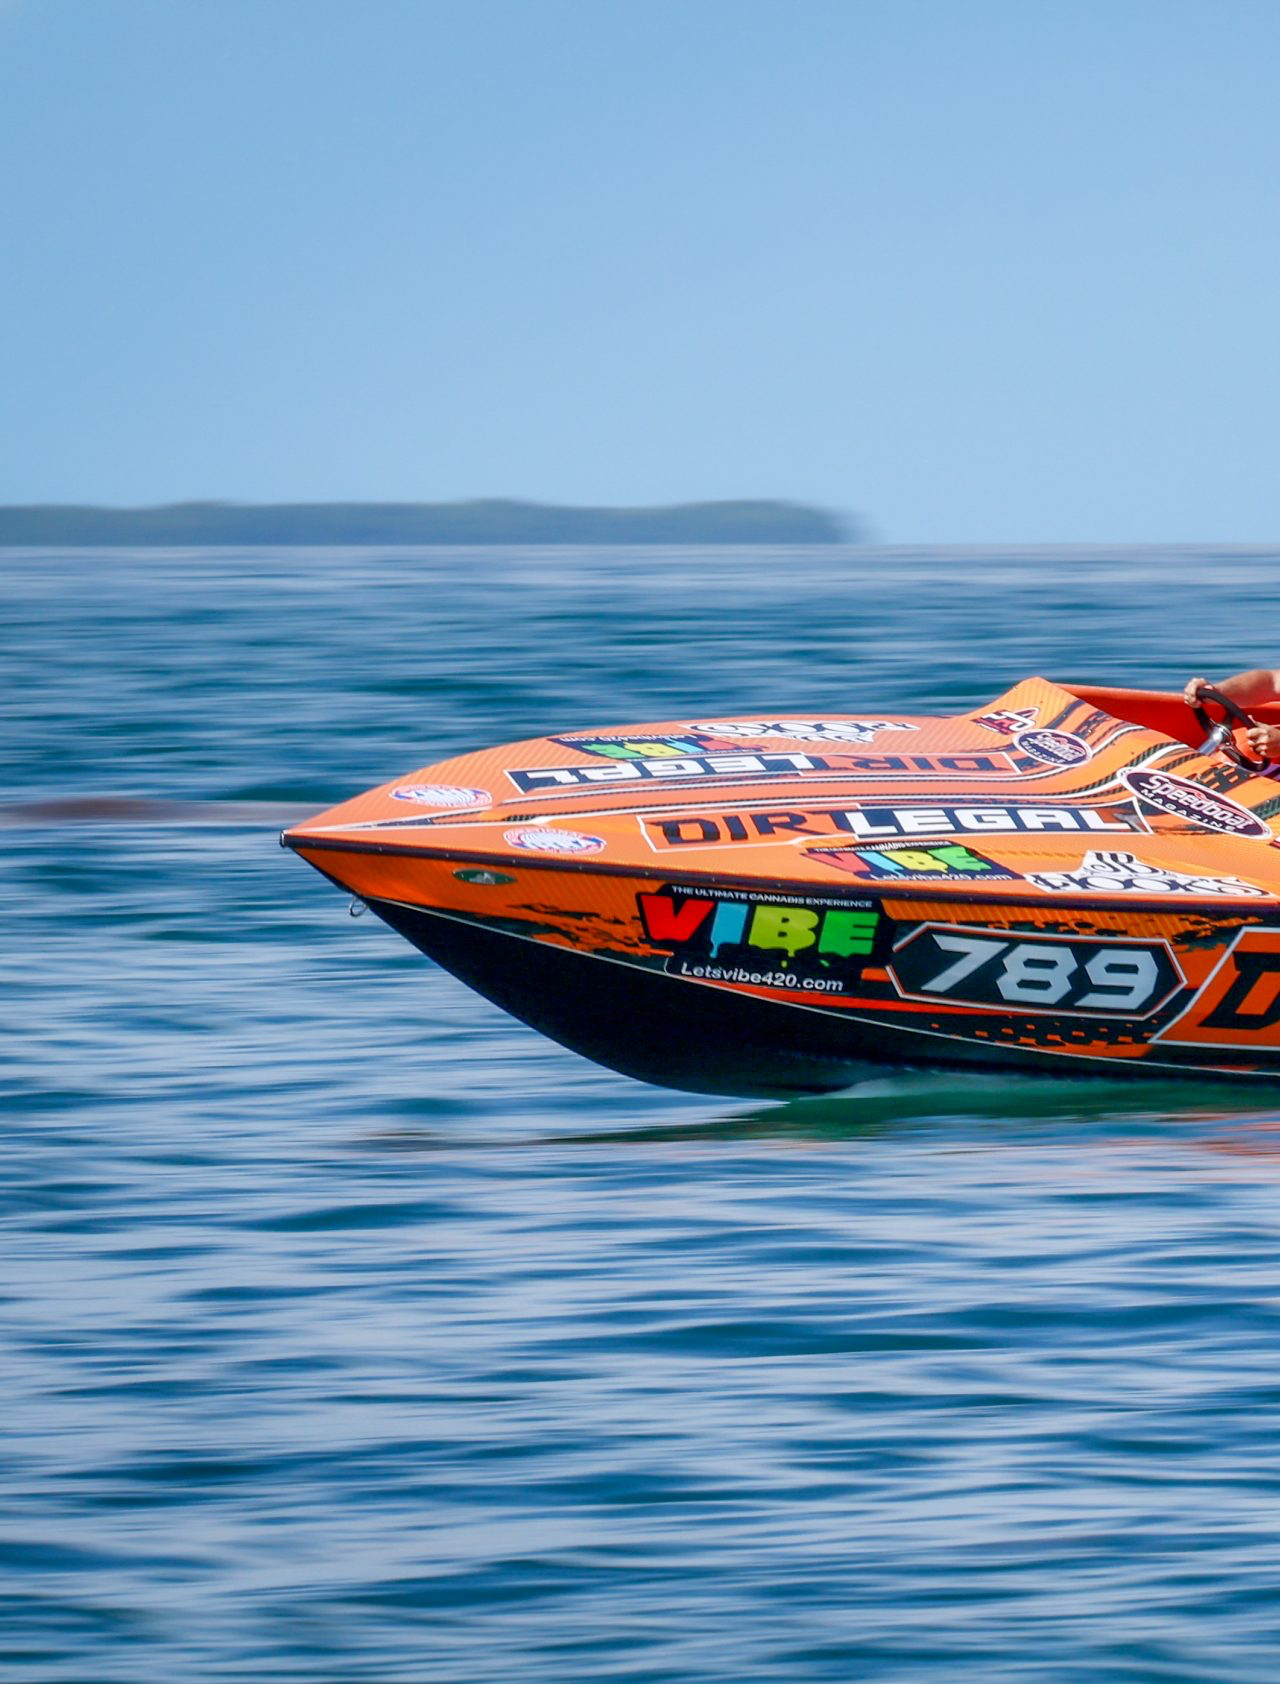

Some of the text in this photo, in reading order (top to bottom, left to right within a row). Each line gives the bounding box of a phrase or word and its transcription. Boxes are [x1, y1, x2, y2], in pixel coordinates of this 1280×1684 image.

[525, 753, 816, 785] LEGAL
[1141, 788, 1238, 832] MAGAZINE
[1142, 775, 1256, 831] Speedboat
[843, 806, 1132, 836] LEGAL
[801, 846, 992, 875] VIBE
[671, 885, 873, 908] THE ULTIMATE CANNABIS EXPERIENCE
[639, 893, 880, 959] VIBE
[680, 961, 844, 992] Letsvibe420.com
[920, 933, 1159, 1010] 789
